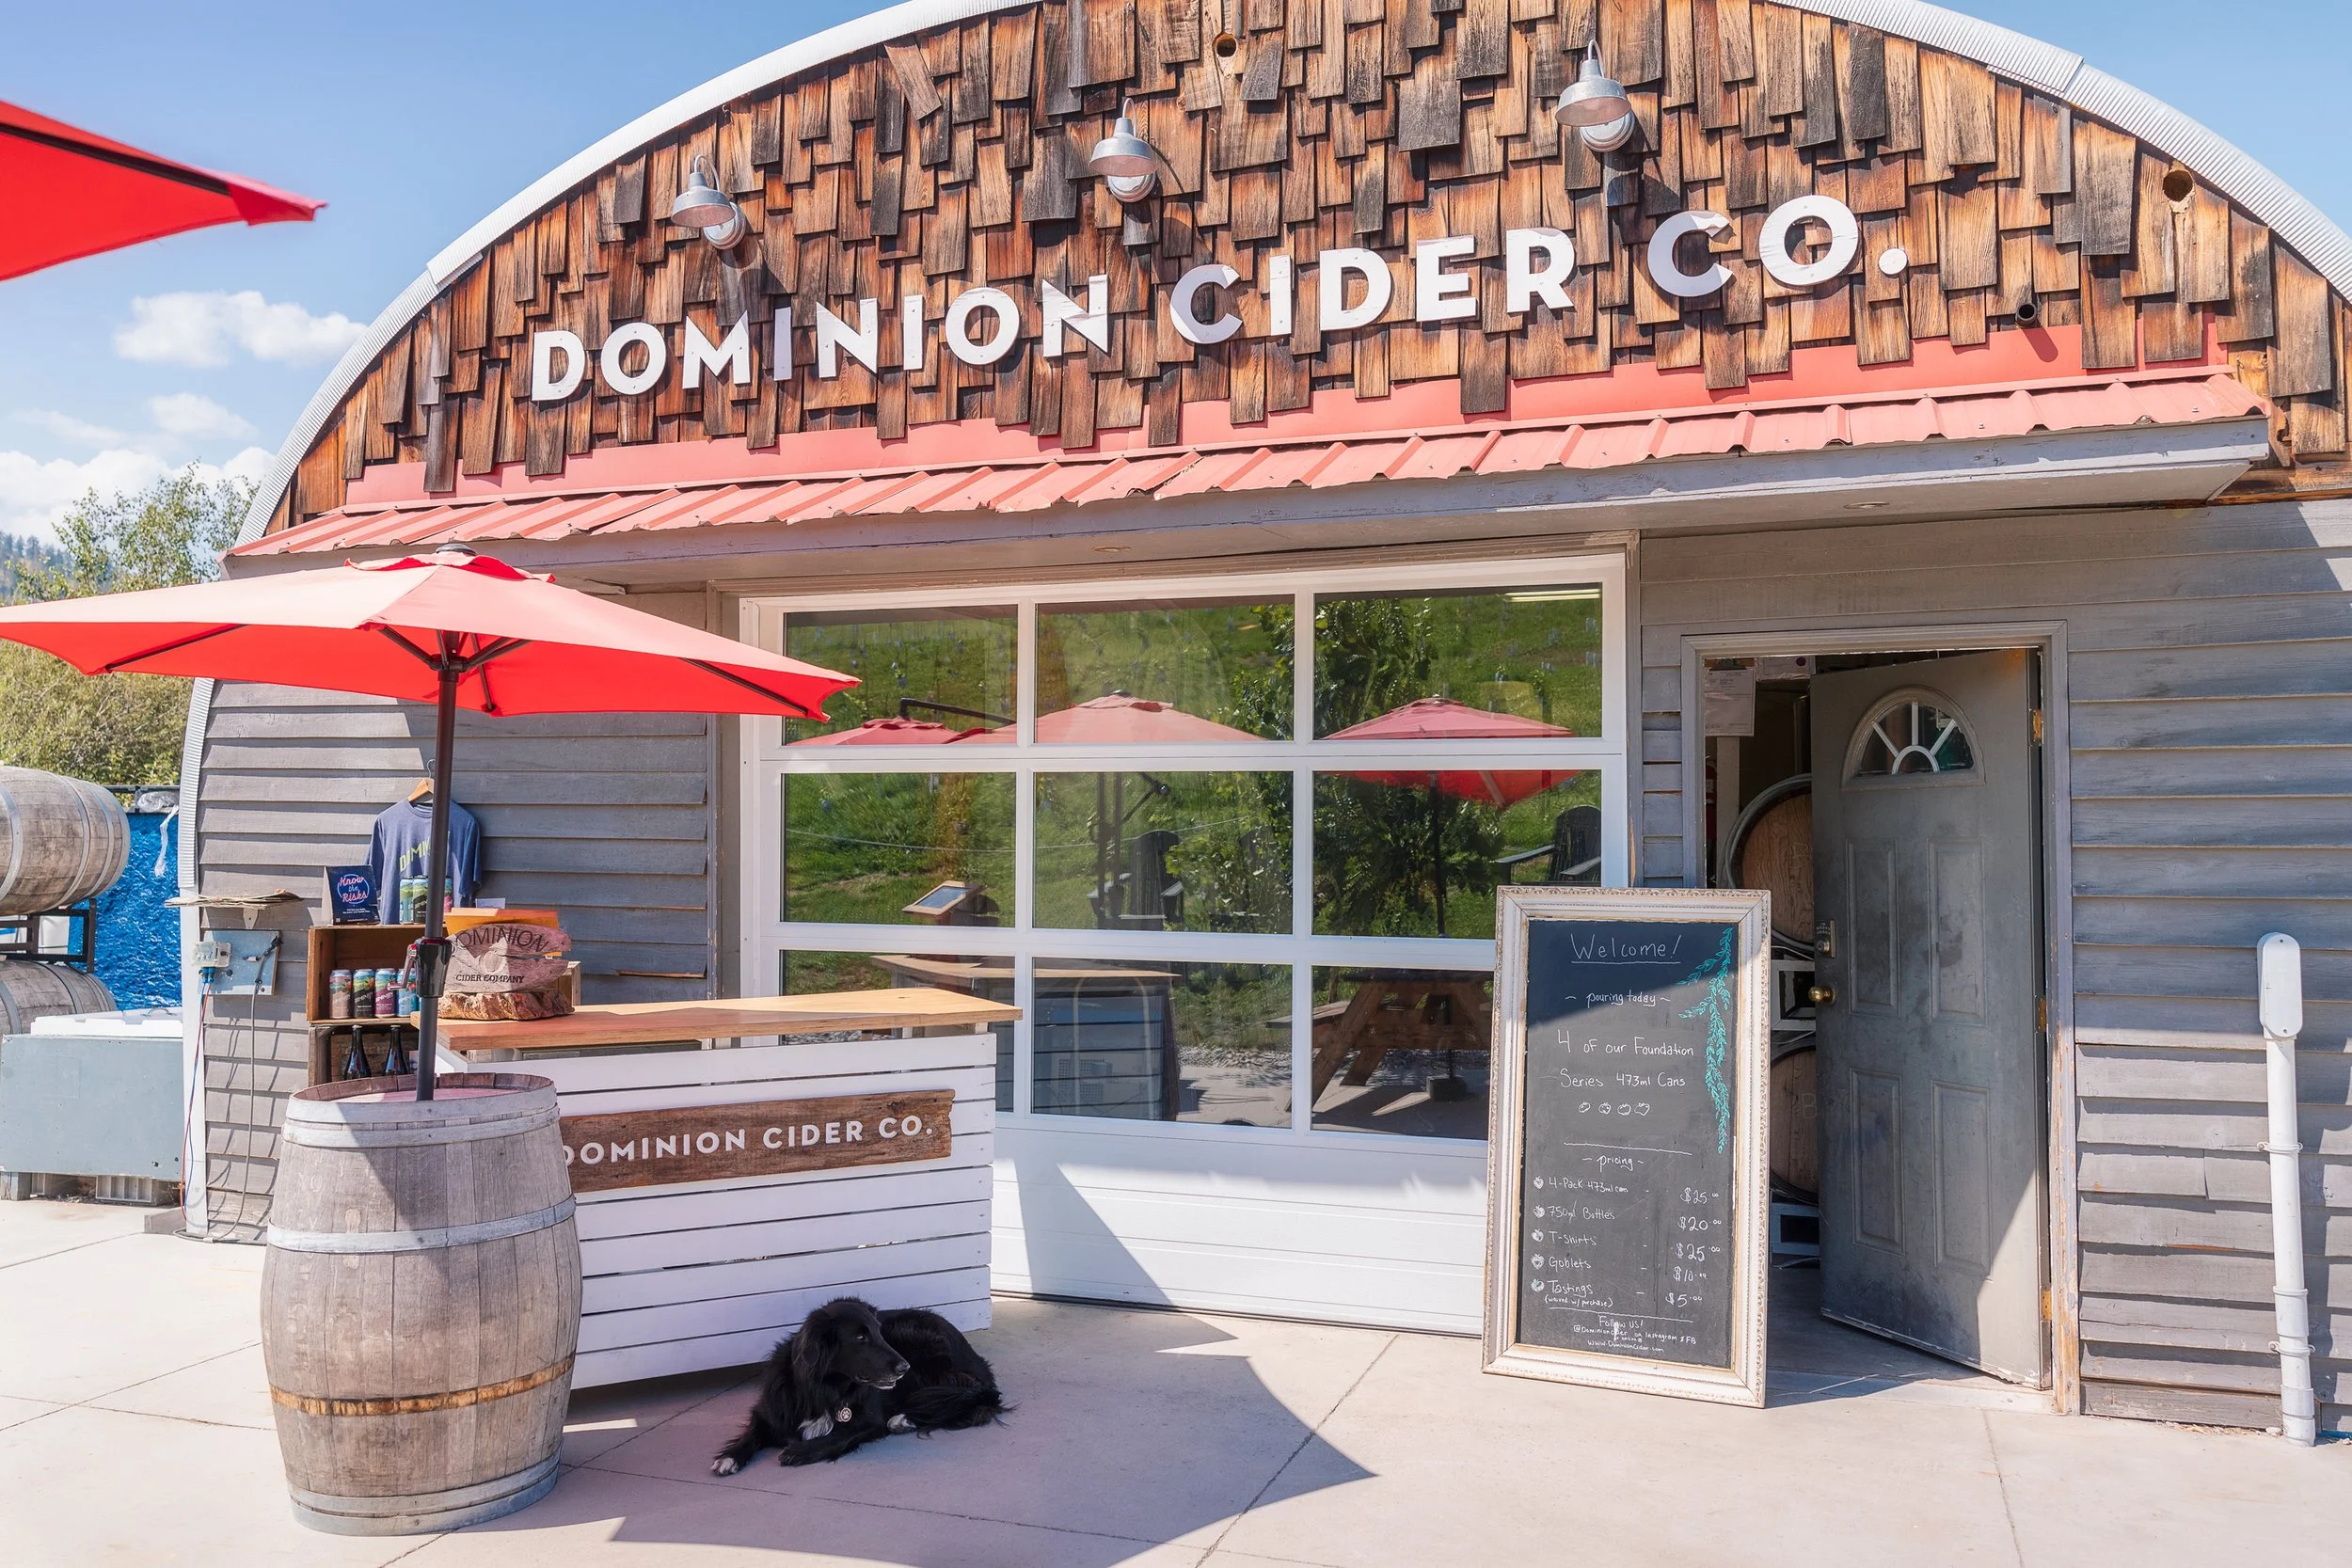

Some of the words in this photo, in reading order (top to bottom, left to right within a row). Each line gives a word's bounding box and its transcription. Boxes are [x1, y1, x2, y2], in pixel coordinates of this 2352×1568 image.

[532, 274, 1108, 401] DOMINION
[1169, 228, 1576, 344] CIDER
[1646, 194, 1909, 297] CO.
[340, 876, 364, 886] Know
[342, 889, 368, 902] Risks
[1570, 933, 1682, 959] Welcome!
[455, 974, 482, 982] CIDER
[483, 974, 525, 984] COMPANY
[1586, 991, 1624, 1008] pouring
[1626, 989, 1656, 1006] today
[1557, 1029, 1571, 1053] 4
[1605, 1042, 1628, 1053] our
[1633, 1036, 1694, 1056] Foundation
[1559, 1068, 1604, 1088] Series
[1615, 1072, 1651, 1087] 473ml
[1657, 1071, 1686, 1087] Cans
[762, 1119, 864, 1149] CIDER
[877, 1115, 933, 1139] CO.
[1597, 1155, 1633, 1173] pricing
[1582, 1206, 1615, 1220] Bottles
[1549, 1256, 1592, 1272] Goblets
[1547, 1279, 1594, 1298] Tastings
[1645, 1331, 1678, 1342] Instagram
[1685, 1336, 1697, 1345] FB
